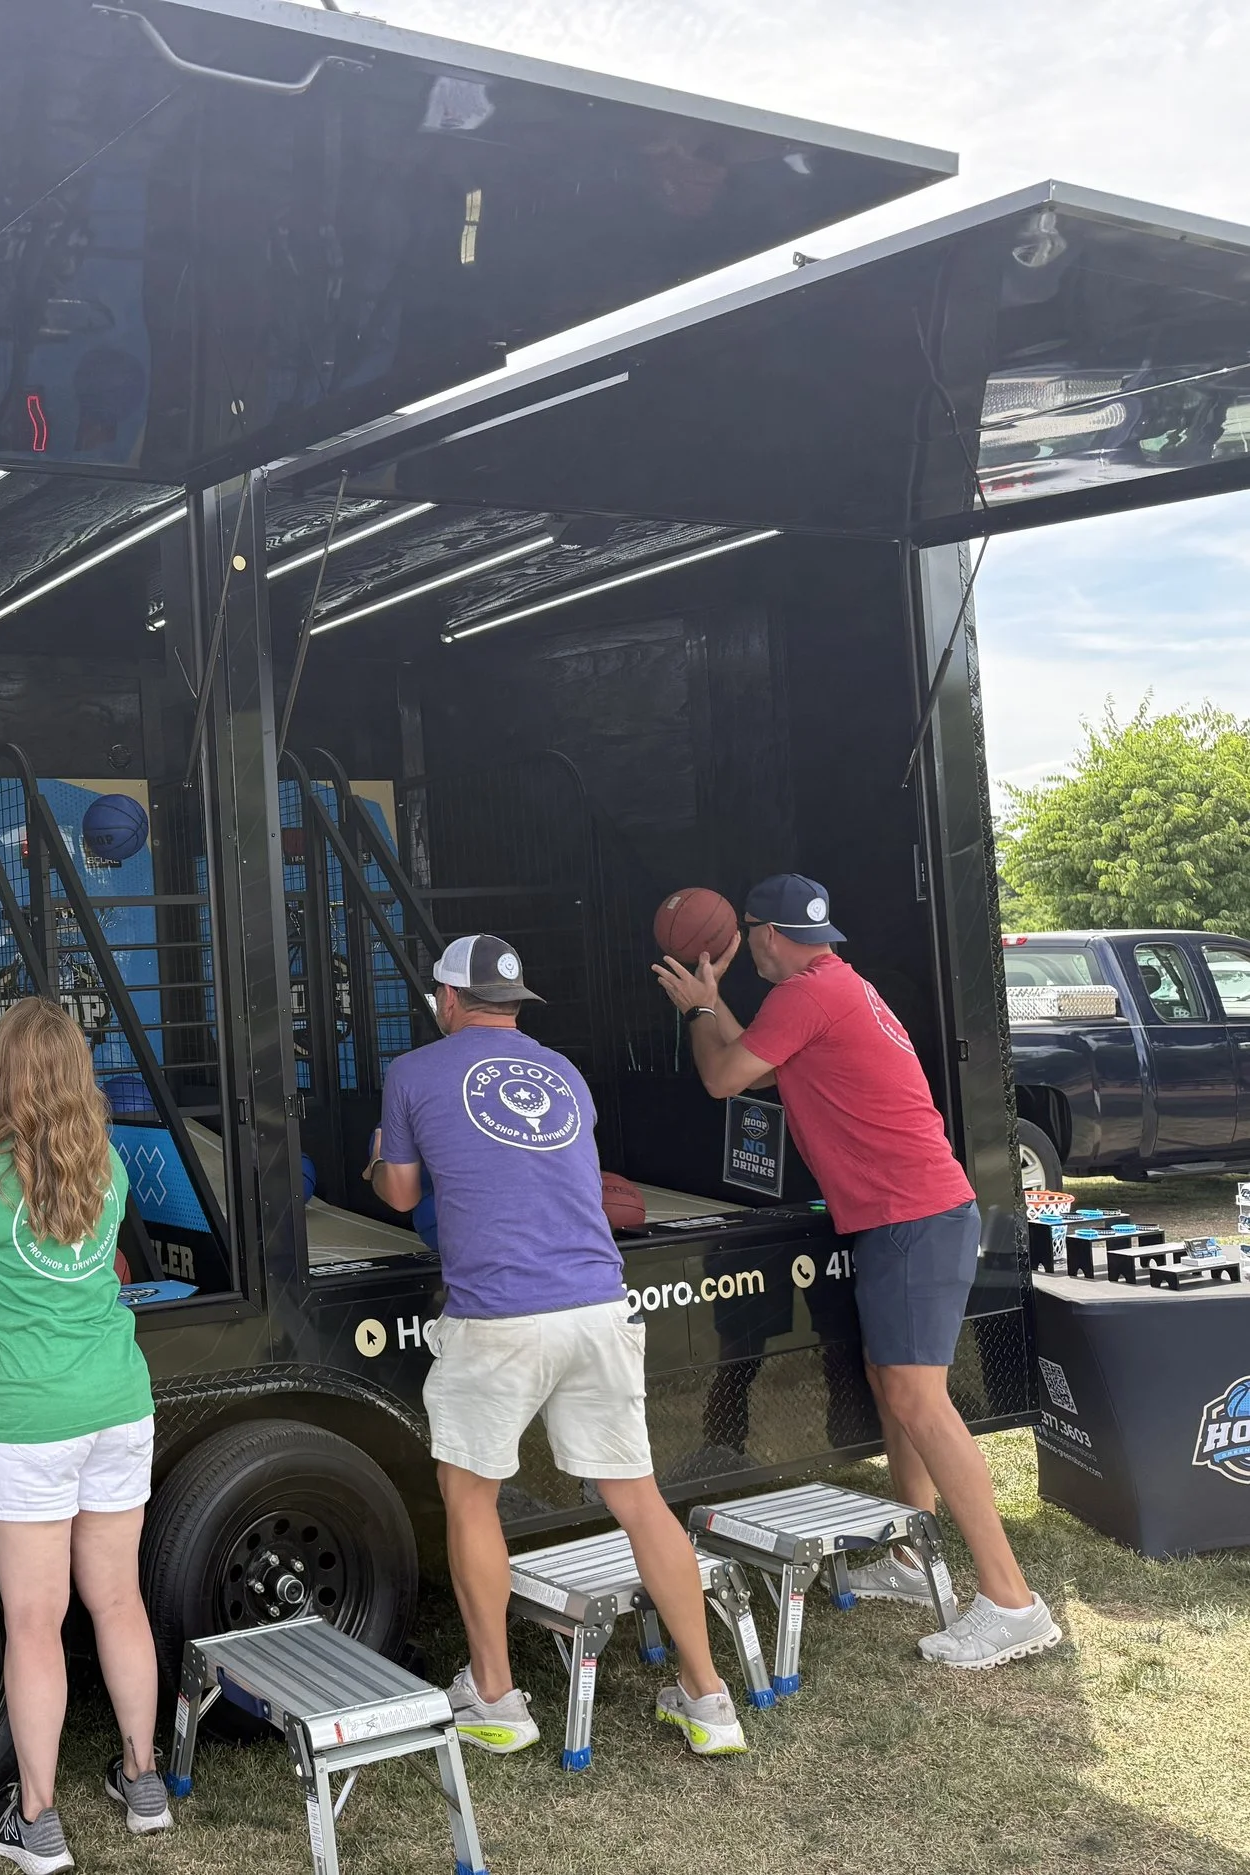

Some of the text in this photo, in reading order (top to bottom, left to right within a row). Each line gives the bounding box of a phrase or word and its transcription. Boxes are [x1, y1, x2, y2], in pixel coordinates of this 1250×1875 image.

[470, 1064, 570, 1098] I-85 GOLF
[479, 1111, 496, 1127] PRO
[494, 1123, 520, 1137] SHOP
[522, 1132, 529, 1141] &
[531, 1128, 566, 1142] DRIVING
[743, 1117, 768, 1131] HOOP
[732, 1148, 776, 1169] FOOD OR
[742, 1138, 766, 1155] NO
[732, 1158, 775, 1178] DRINKS
[27, 1241, 42, 1259] PRO
[40, 1256, 63, 1271] SHOP
[64, 1263, 70, 1272] &
[825, 1250, 857, 1280] 41
